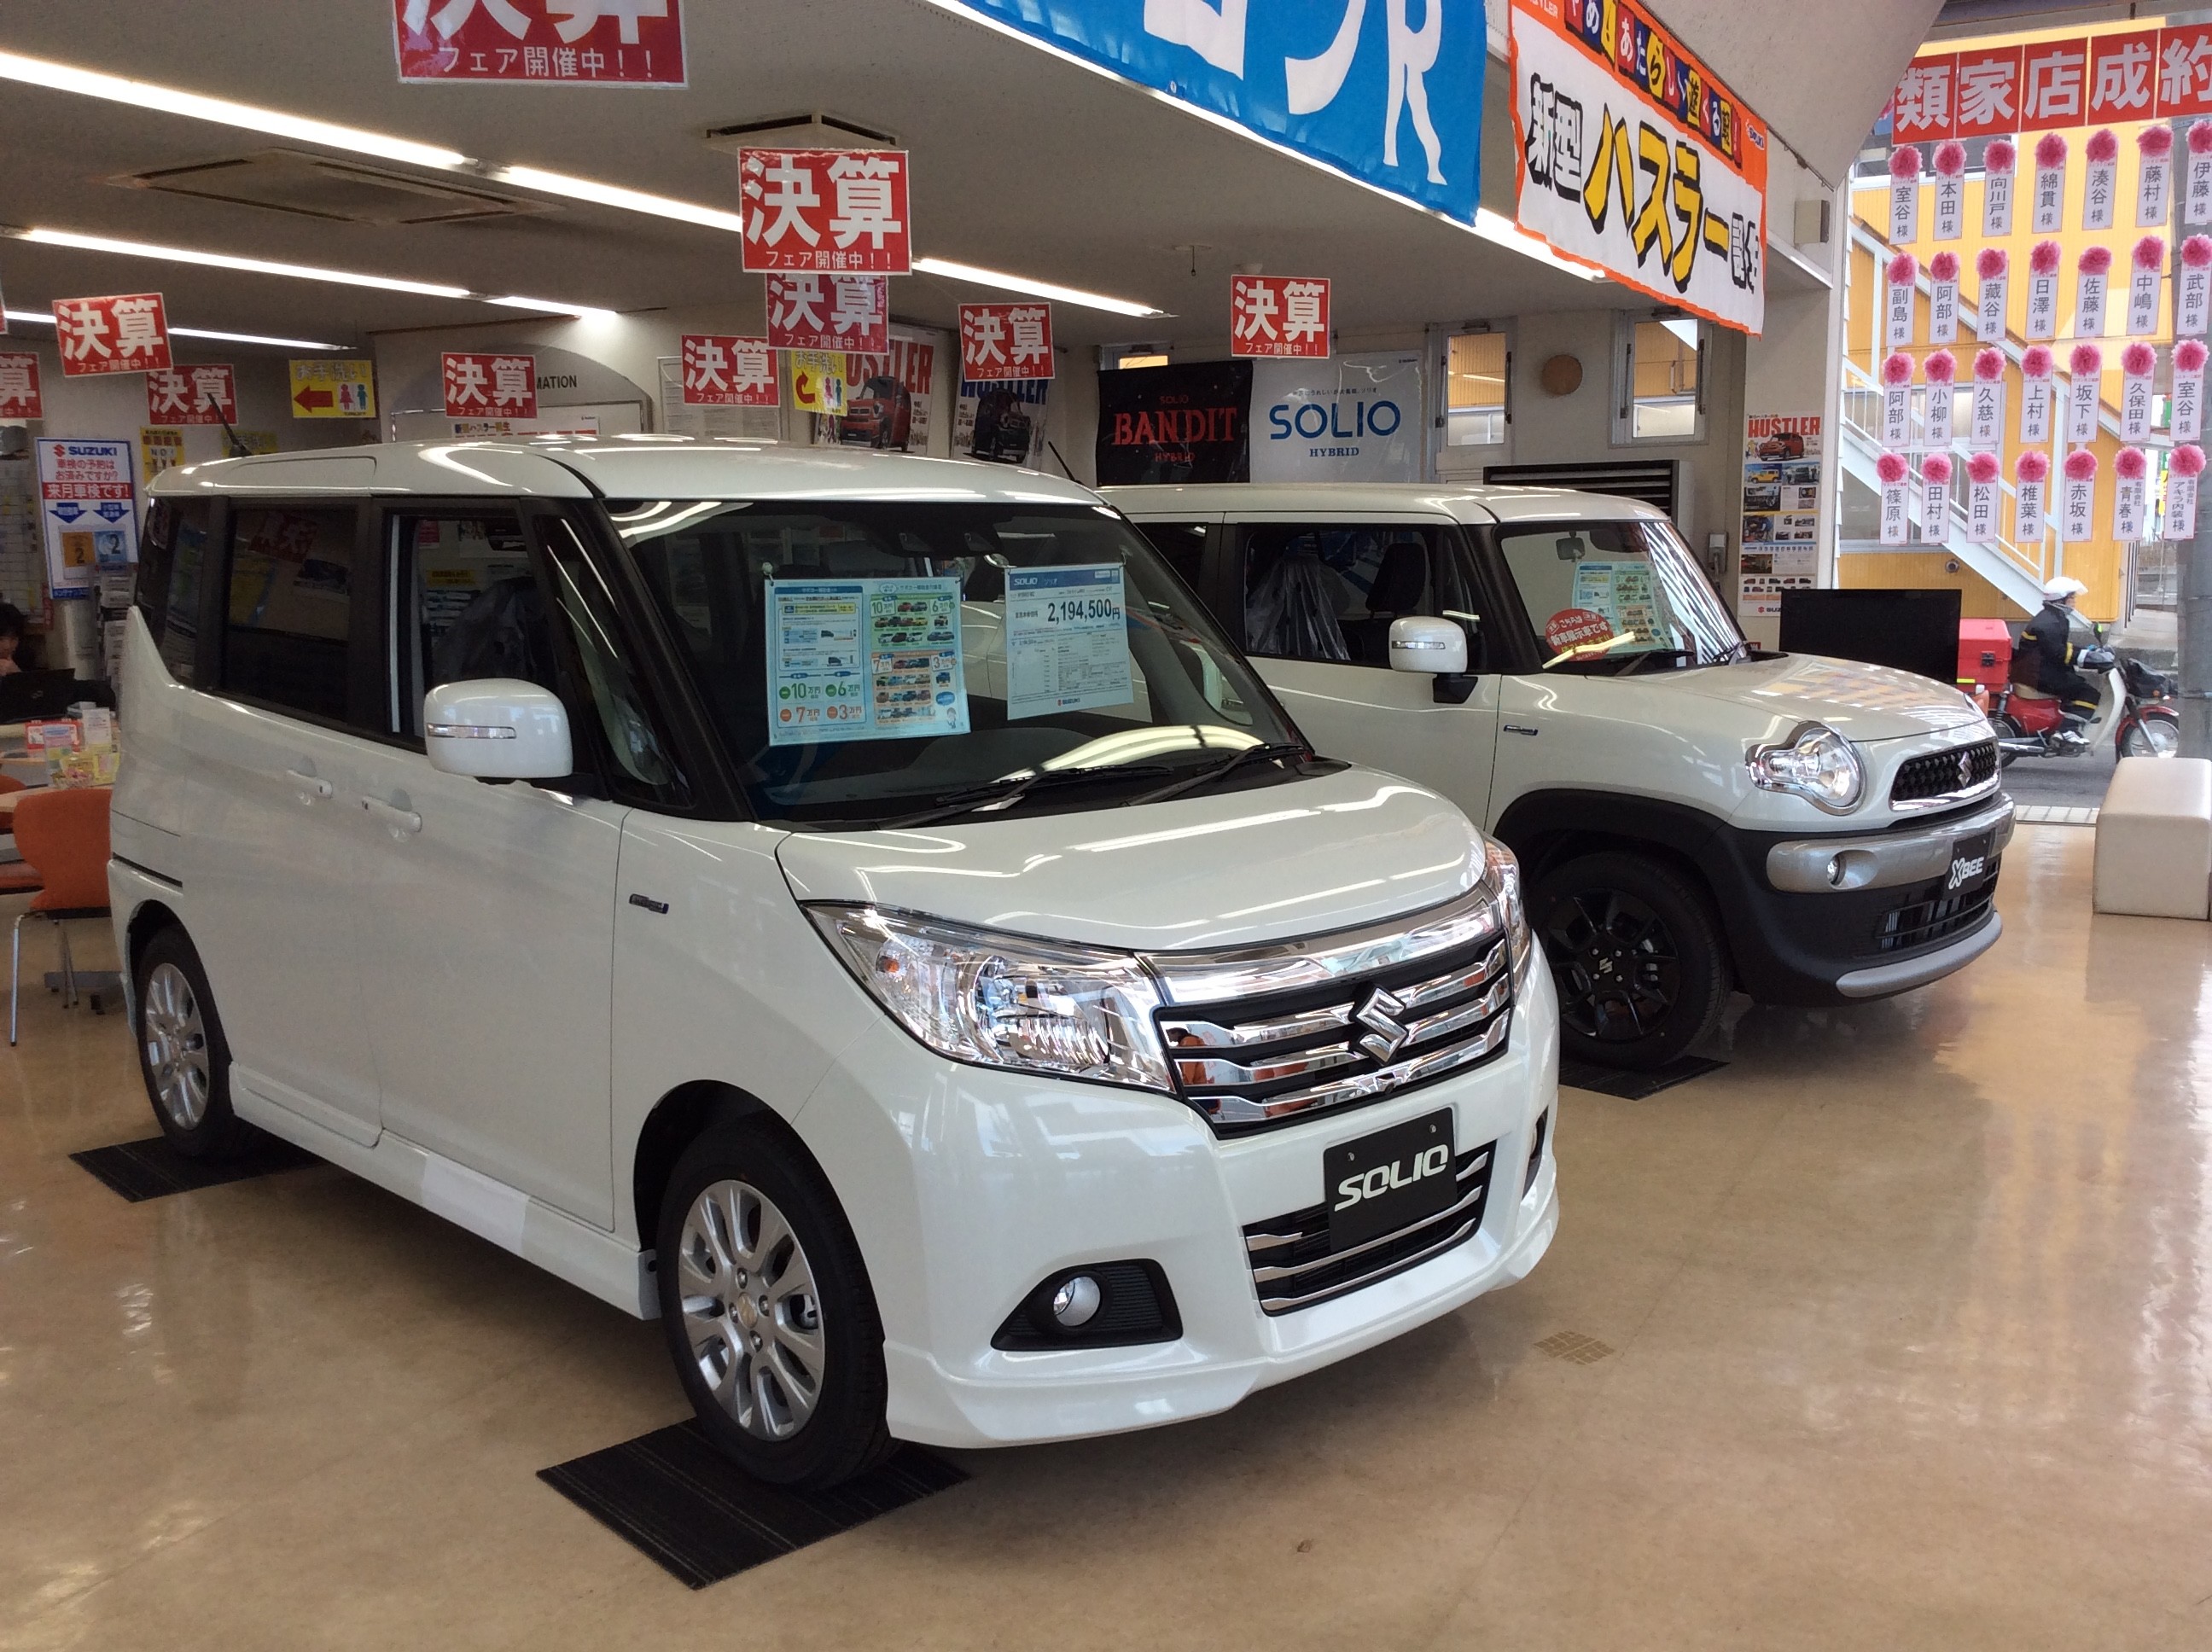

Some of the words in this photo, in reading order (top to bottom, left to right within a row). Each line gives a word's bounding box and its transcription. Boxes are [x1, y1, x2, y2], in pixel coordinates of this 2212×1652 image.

[1896, 34, 2212, 133] 類家店成約
[745, 154, 901, 249] 決算
[770, 273, 882, 335] 決算
[1234, 281, 1324, 342] 決算
[58, 299, 164, 359] 決算
[963, 307, 1048, 366] 決算
[445, 358, 533, 407] 決算
[684, 339, 774, 393] 決算
[148, 367, 232, 414] 決算
[1112, 407, 1237, 445] BANDIT
[1269, 400, 1401, 440] SOLIO
[1748, 416, 1820, 438] HUSTLER
[68, 447, 117, 457] SUZUKI
[1309, 447, 1360, 457] HYBRID
[1014, 577, 1038, 586] SOLIO
[1047, 599, 1121, 625] 2,194,500円
[1948, 856, 1985, 890] XBEE
[1334, 1143, 1449, 1213] SOLIO
